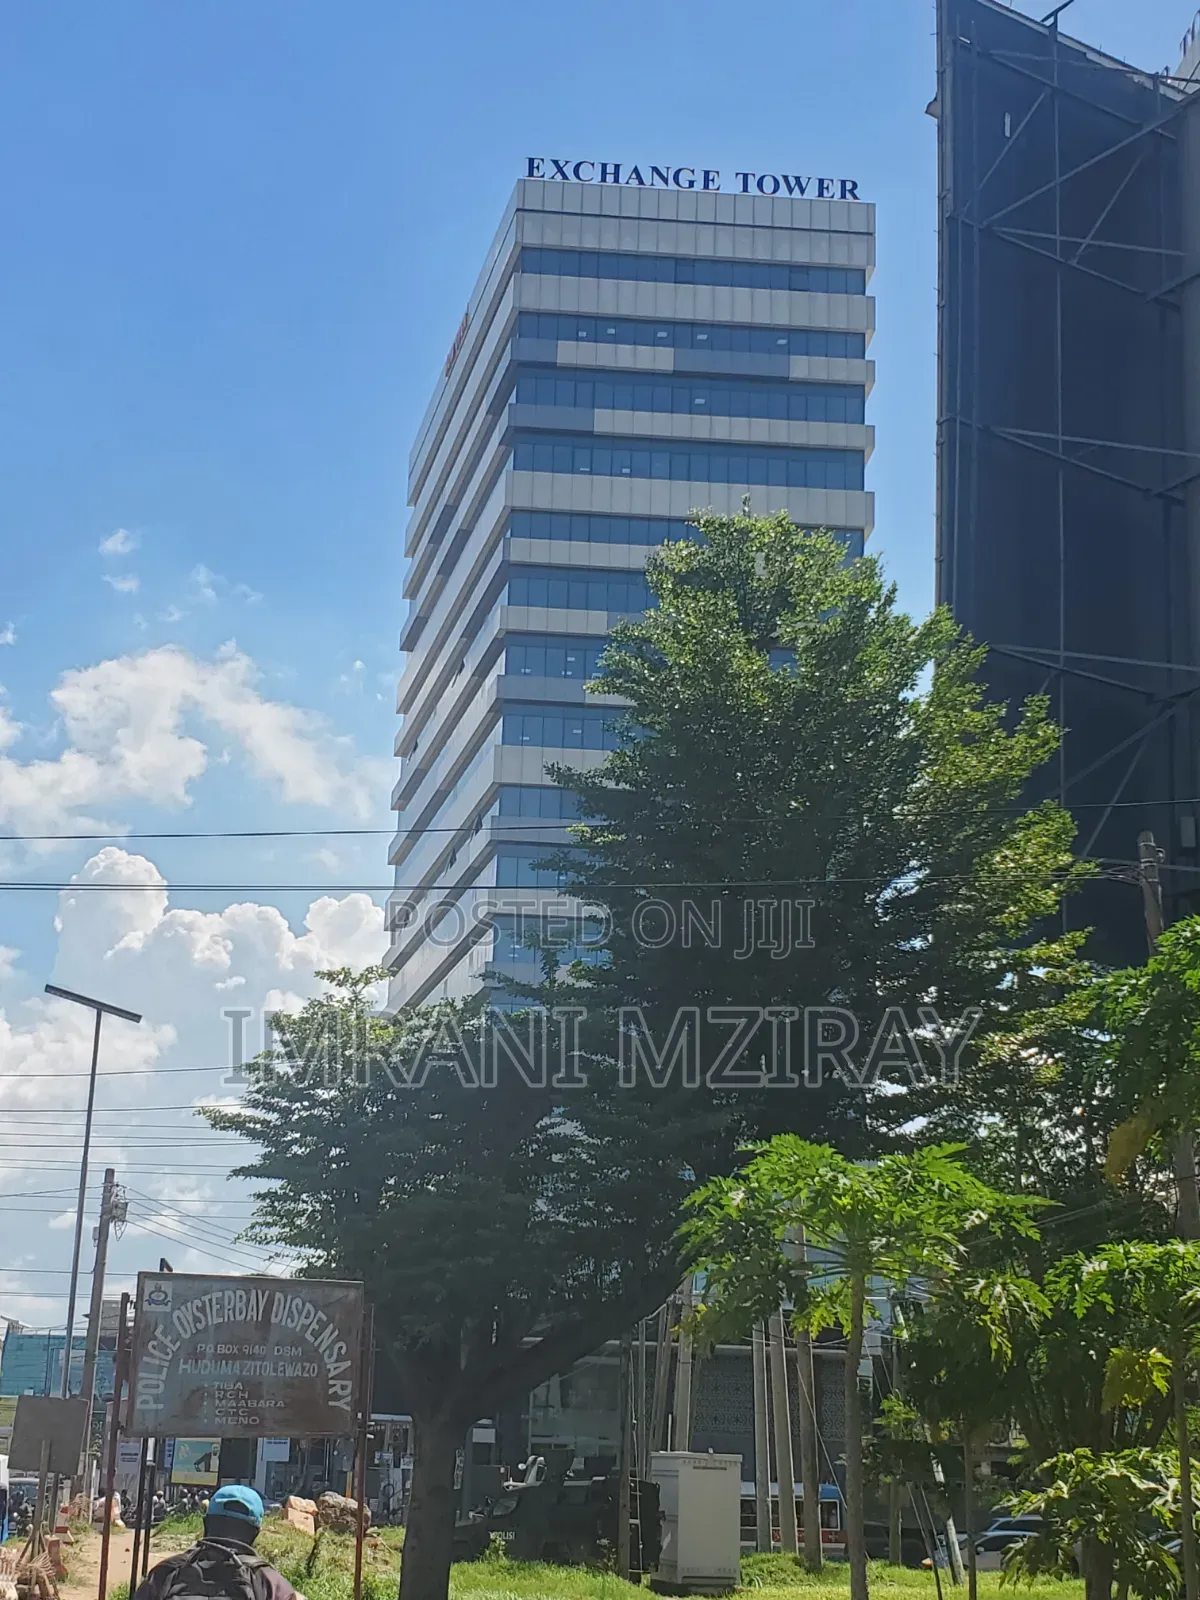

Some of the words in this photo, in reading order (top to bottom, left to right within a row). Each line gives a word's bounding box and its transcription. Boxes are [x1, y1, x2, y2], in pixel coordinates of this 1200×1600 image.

[525, 157, 721, 191] EXCHANGE
[735, 171, 862, 201] TOWER
[137, 1324, 181, 1411] POLICE
[172, 1289, 270, 1340] OYSTERBAY
[271, 1291, 353, 1413] DISPENSARY
[217, 1344, 239, 1354] BOX
[274, 1346, 302, 1357] DSM
[178, 1358, 241, 1375] HUDUMA
[242, 1360, 318, 1378] ZITOLEWAZO
[214, 1399, 286, 1408] MAABARA
[214, 1416, 260, 1425] MENO
